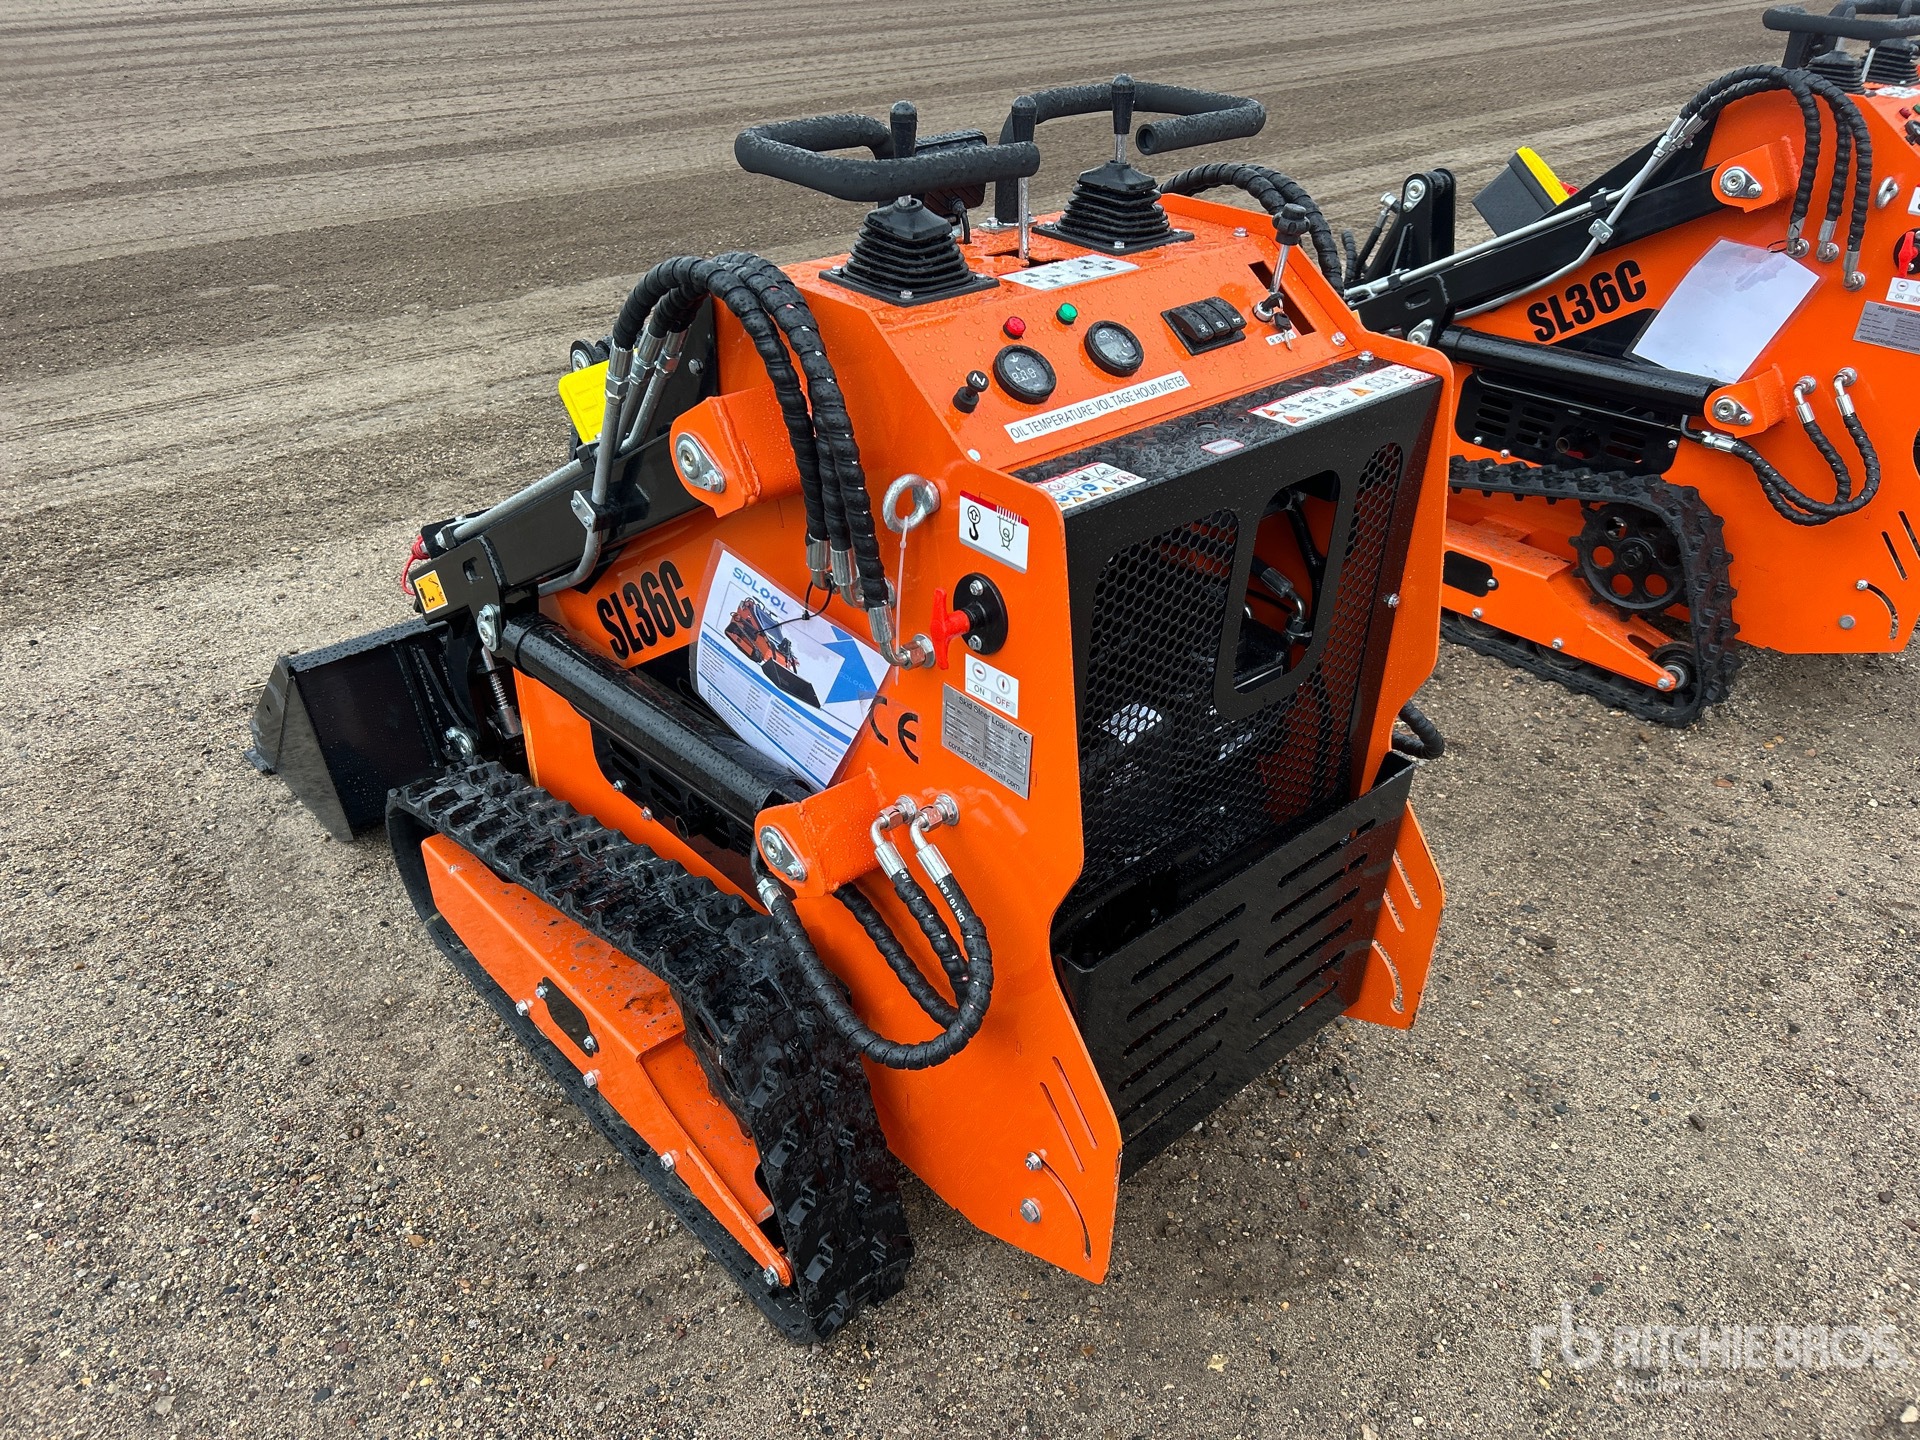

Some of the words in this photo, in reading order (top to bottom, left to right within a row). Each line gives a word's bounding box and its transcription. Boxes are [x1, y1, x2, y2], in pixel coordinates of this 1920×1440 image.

[1527, 260, 1647, 342] SL36C
[1010, 426, 1028, 439] OIL
[1026, 404, 1095, 433] TEMPERATURE
[1093, 391, 1136, 412] VOLTAGE
[1135, 385, 1159, 400] HOUR
[1158, 375, 1188, 392] METER
[733, 567, 788, 614] SDLOOL
[597, 561, 694, 660] SL36C
[974, 685, 985, 695] ON
[959, 696, 973, 710] Skid
[996, 697, 1011, 708] OFF
[949, 898, 957, 909] 10
[955, 908, 966, 923] DN
